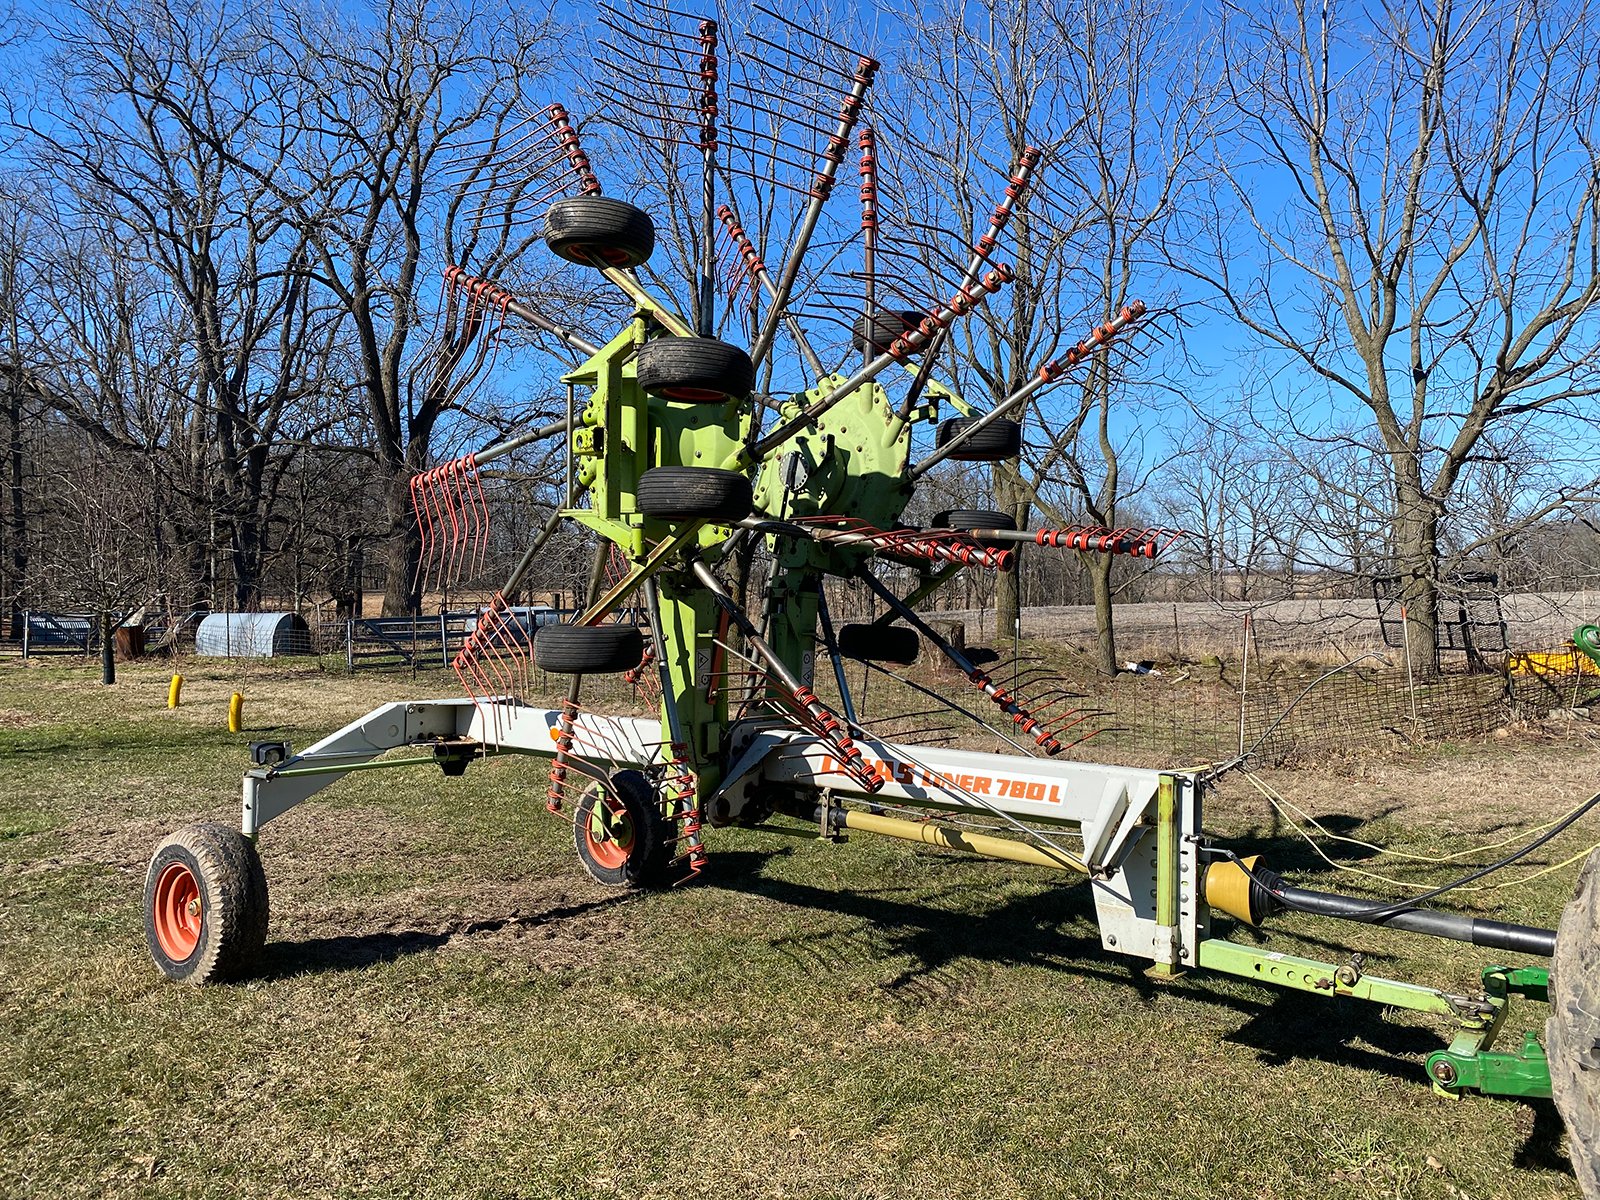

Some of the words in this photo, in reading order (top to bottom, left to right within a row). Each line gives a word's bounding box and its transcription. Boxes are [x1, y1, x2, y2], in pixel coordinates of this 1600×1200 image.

[921, 769, 992, 795] LINER
[996, 778, 1047, 801] 780
[1048, 784, 1061, 804] L
